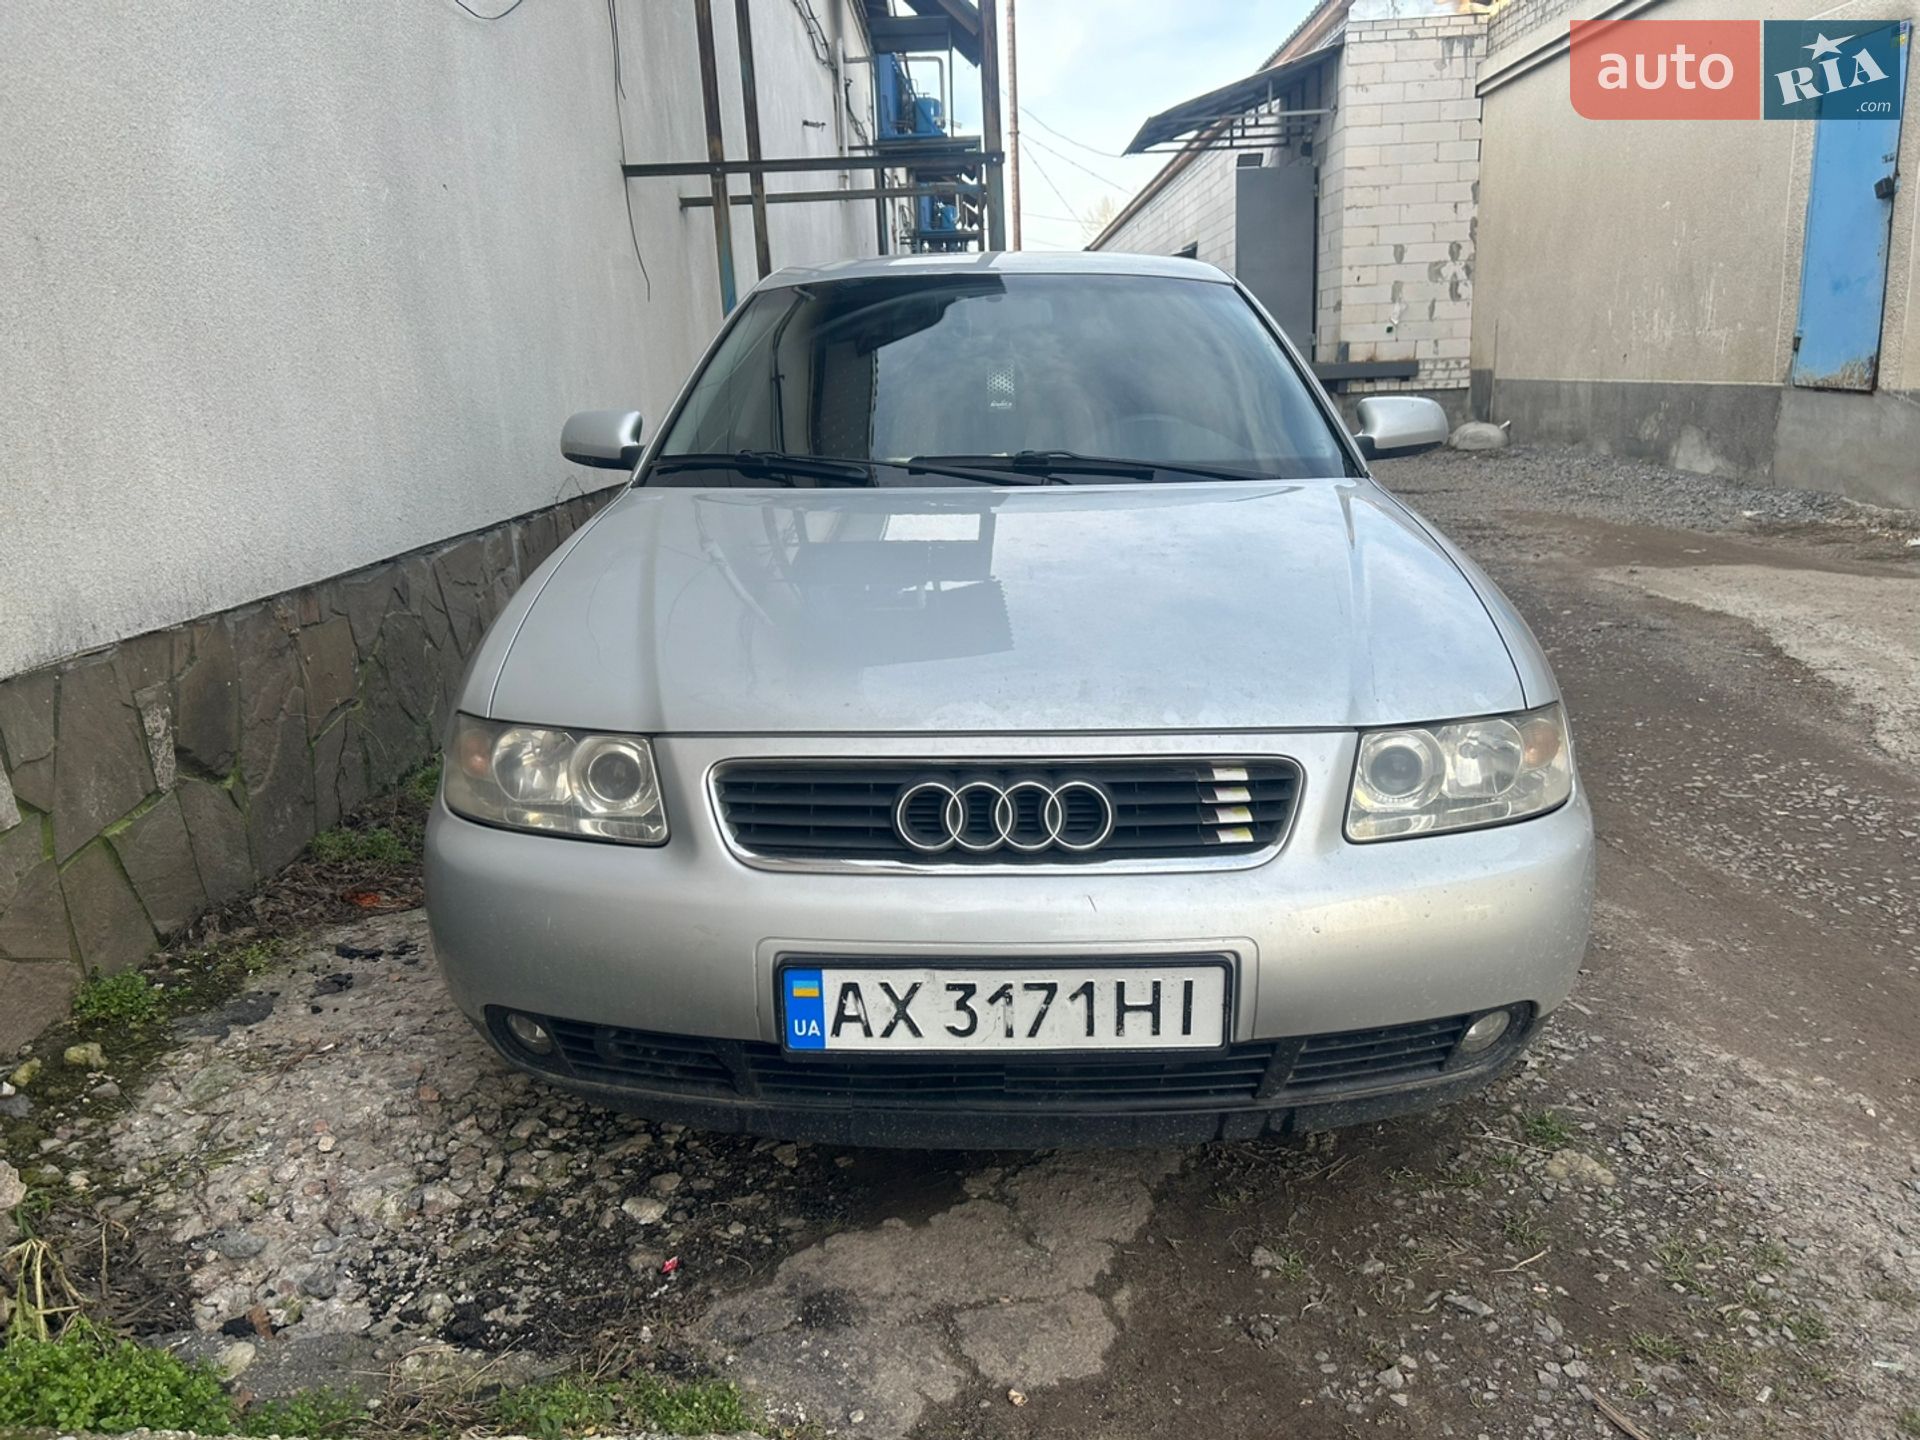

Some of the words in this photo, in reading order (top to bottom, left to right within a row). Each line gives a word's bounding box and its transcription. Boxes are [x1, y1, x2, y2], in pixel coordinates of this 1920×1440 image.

[831, 982, 922, 1037] AX
[945, 982, 1096, 1038] 3171
[1115, 980, 1193, 1036] HI
[795, 1020, 821, 1037] UA
